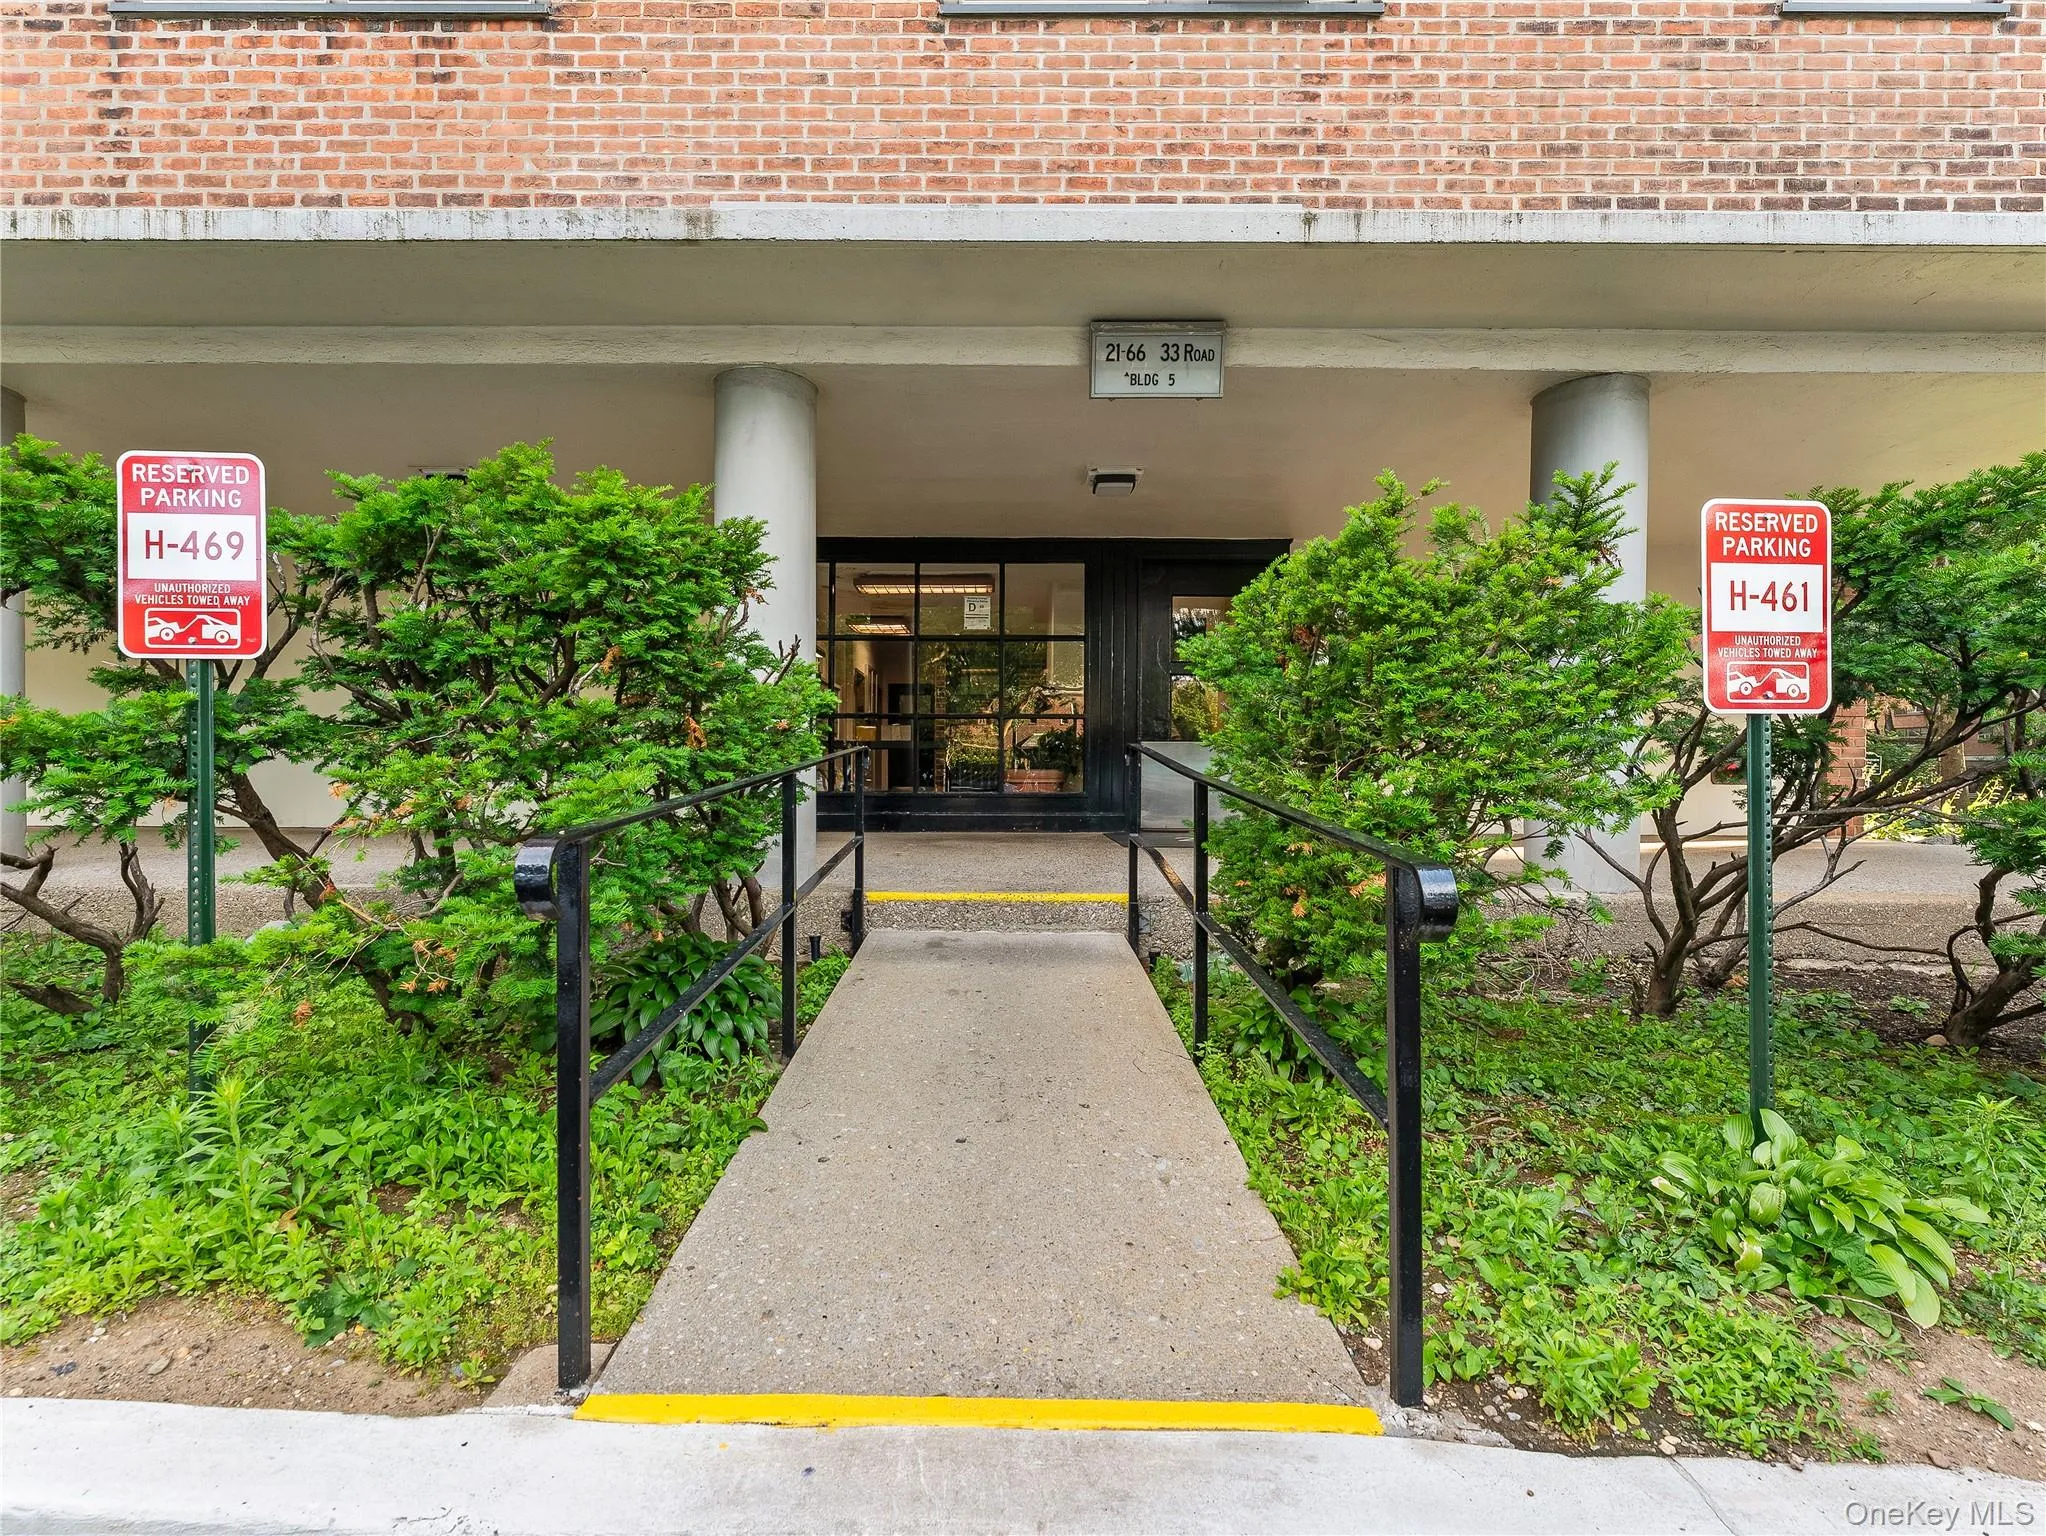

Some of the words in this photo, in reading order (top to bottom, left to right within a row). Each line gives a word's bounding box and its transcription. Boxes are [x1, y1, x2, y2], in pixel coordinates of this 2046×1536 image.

[1105, 343, 1146, 362] 21-66
[1160, 343, 1180, 362] 33
[1130, 373, 1159, 386] BLDG
[1168, 373, 1176, 386] 5
[132, 463, 250, 485] RESERVED
[140, 487, 242, 508] PARKING
[1715, 511, 1818, 533] RESERVED
[145, 529, 244, 561] H-469
[1723, 537, 1811, 558] PARKING
[154, 582, 231, 594] UNAUTHORIZED
[1730, 580, 1808, 612] H-461
[135, 594, 184, 605] VEHICLES
[187, 595, 220, 606] TOWED
[223, 595, 250, 606] AWAY
[969, 603, 976, 611] D
[1734, 635, 1801, 646] UNAUTHORIZED
[1717, 647, 1761, 658] VEHICLES
[1763, 647, 1792, 658] TOWED
[1794, 648, 1818, 659] AWAY
